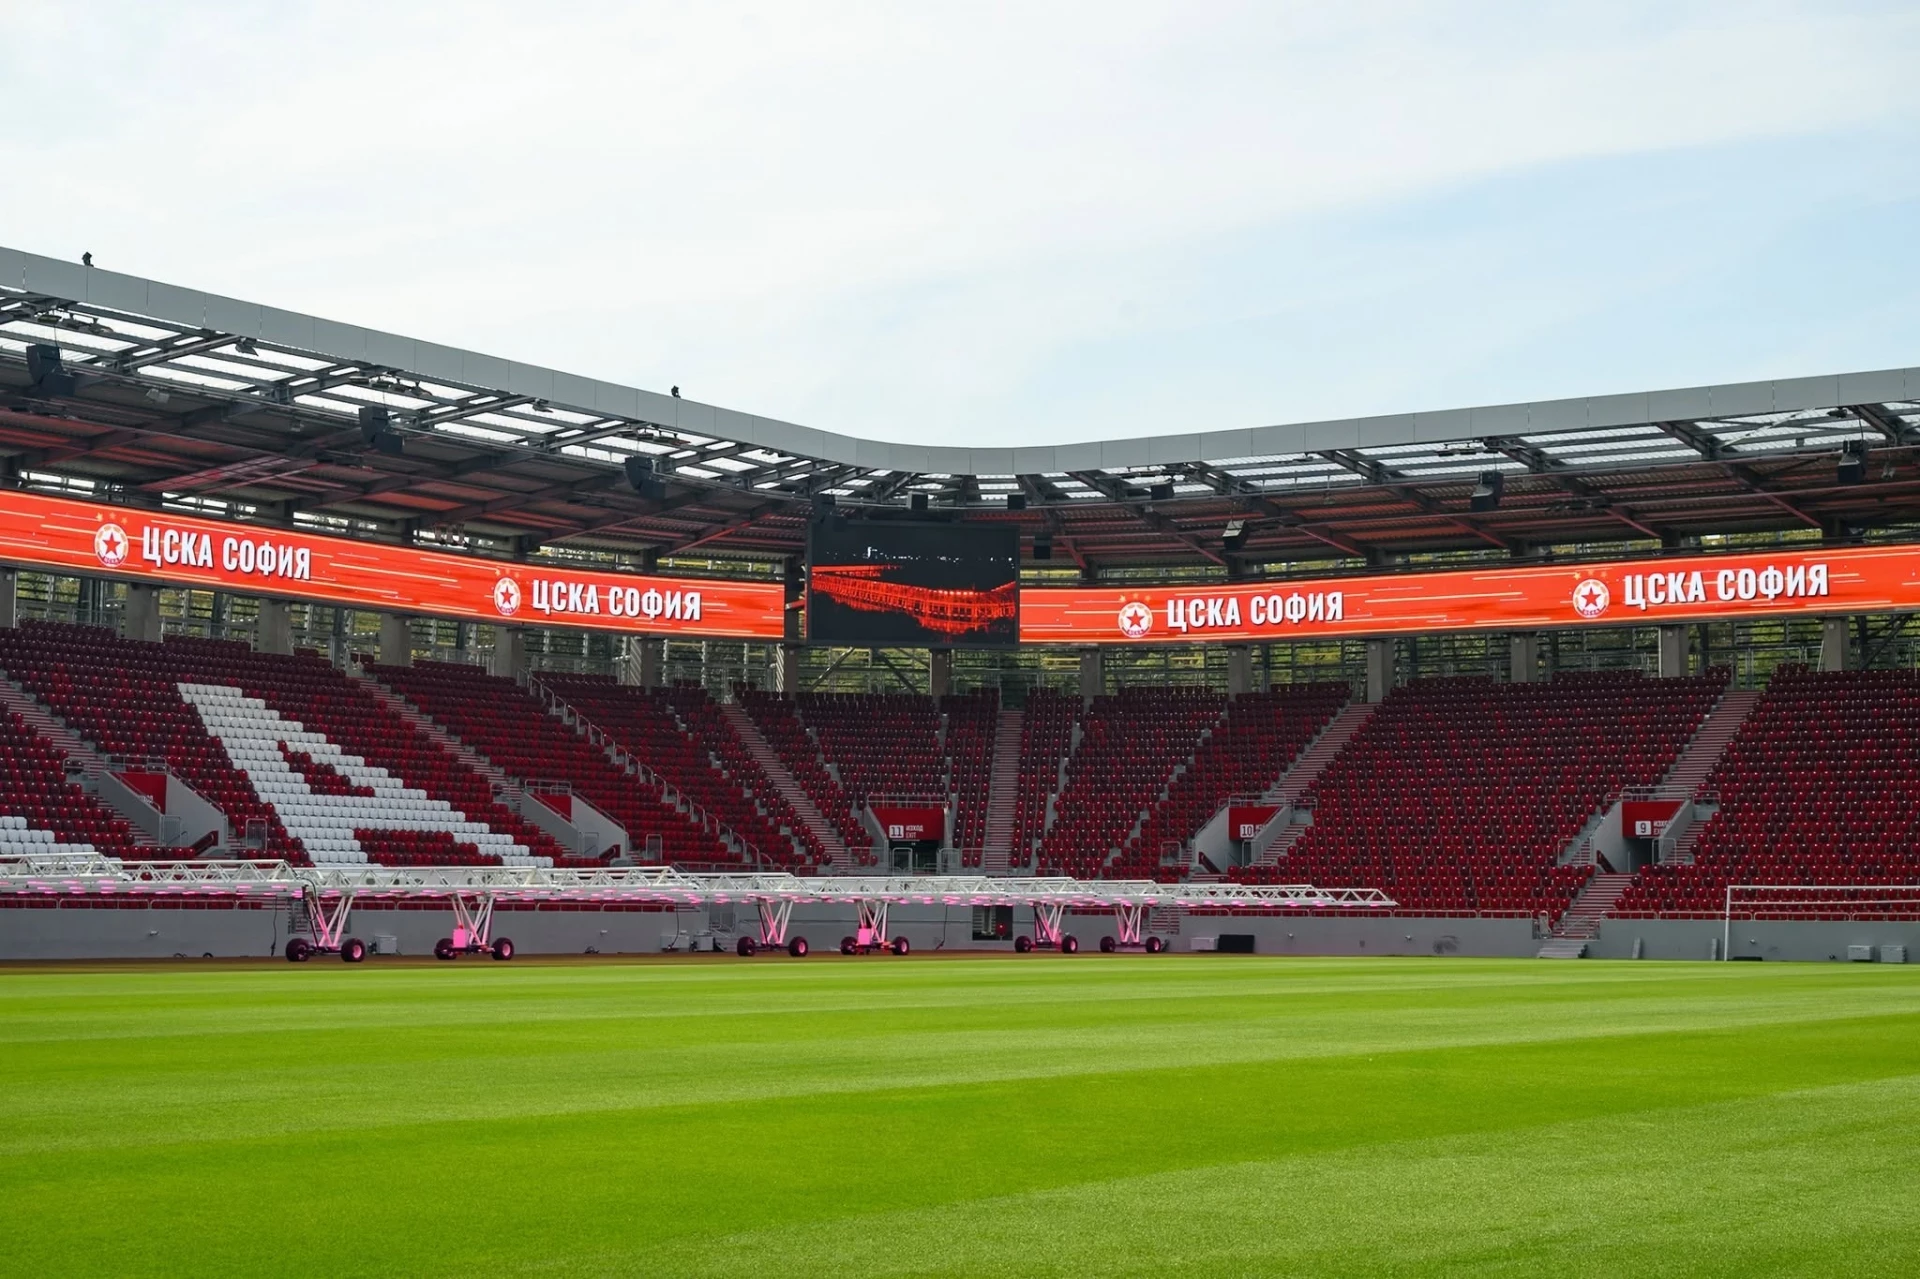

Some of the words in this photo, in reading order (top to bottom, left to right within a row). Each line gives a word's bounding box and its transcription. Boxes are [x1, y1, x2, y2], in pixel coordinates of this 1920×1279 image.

[142, 525, 214, 568] ЦСКА
[222, 537, 311, 580] СОФИЯ
[532, 579, 600, 614] ЦСКА
[608, 586, 701, 620] СОФИЯ
[1624, 571, 1706, 611] ЦСКА
[1716, 564, 1828, 600] СОФИЯ
[1167, 597, 1241, 633] ЦСКА
[1250, 592, 1343, 625] СОФИЯ
[890, 826, 903, 837] 11
[1242, 825, 1253, 837] 10
